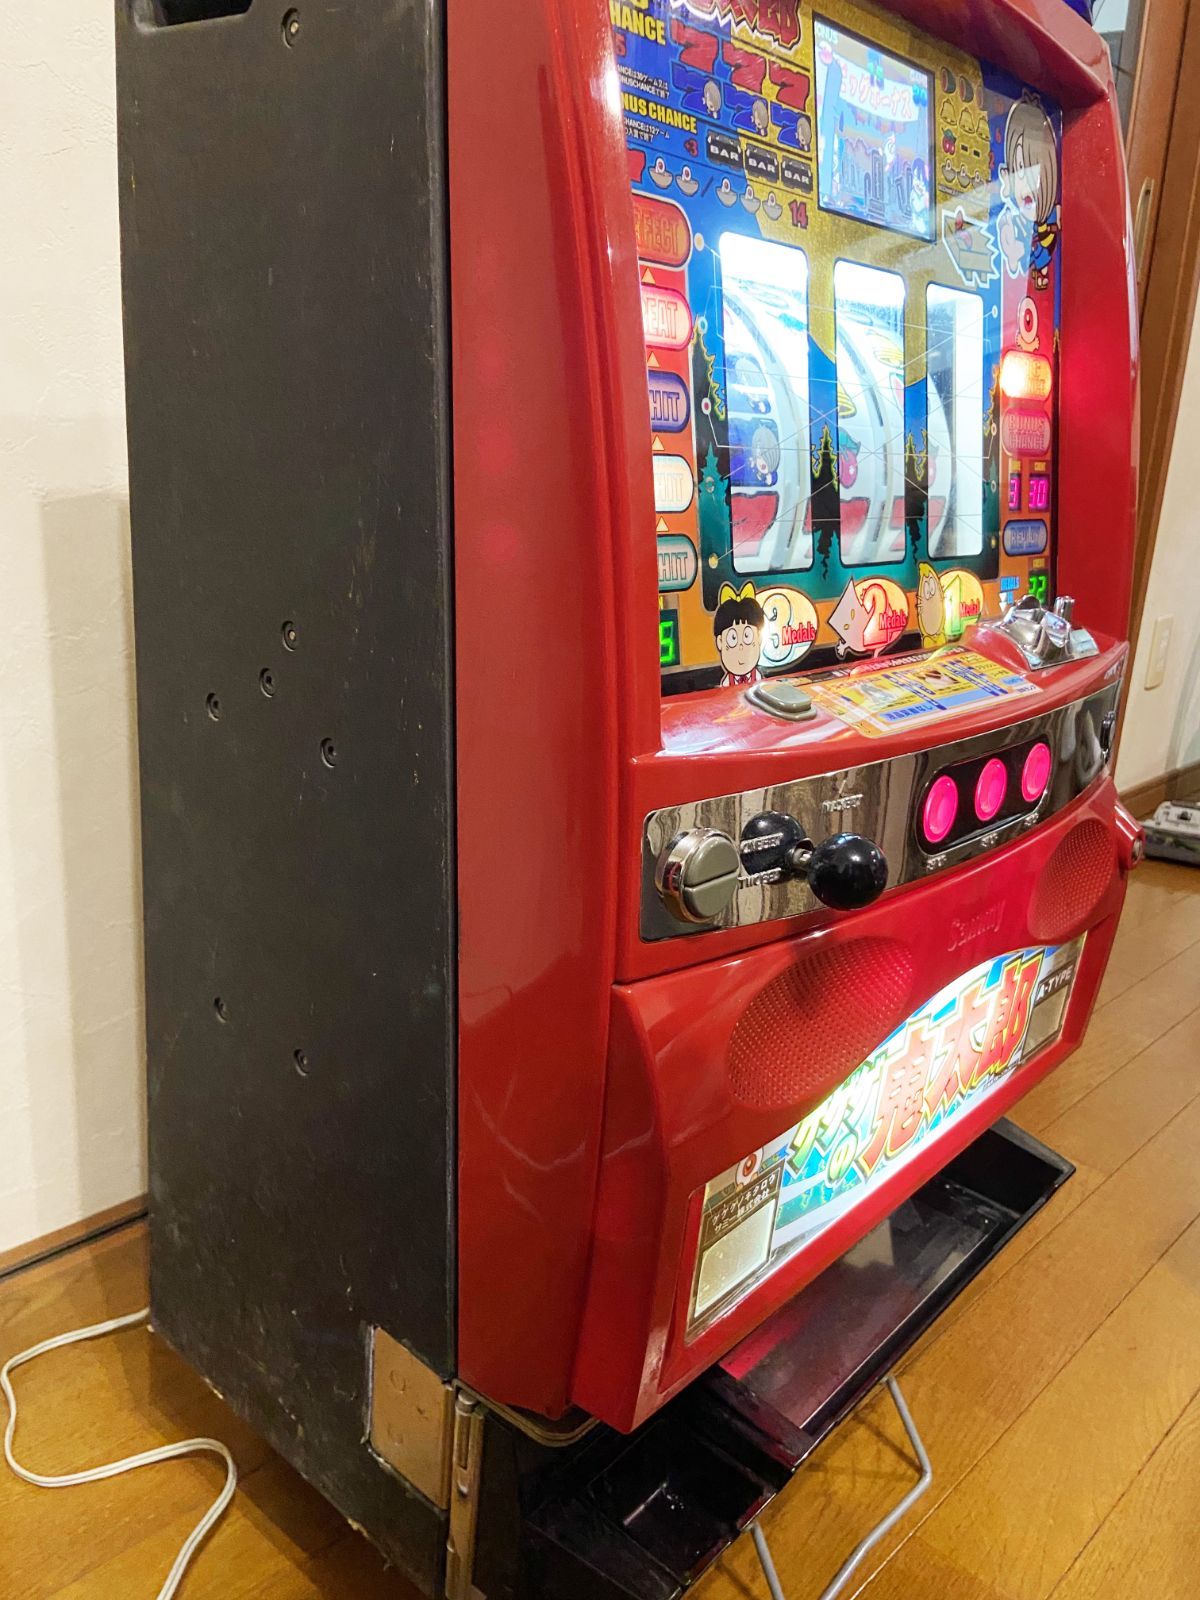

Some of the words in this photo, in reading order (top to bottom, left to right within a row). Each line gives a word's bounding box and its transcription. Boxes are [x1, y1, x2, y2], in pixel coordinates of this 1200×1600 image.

[648, 101, 698, 134] CHANCE
[710, 144, 739, 161] BAR
[748, 157, 776, 173] BAR
[784, 170, 810, 184] BAR
[788, 200, 809, 229] 14
[643, 296, 678, 340] EAT
[1008, 413, 1045, 432] BONUS
[1008, 479, 1018, 508] 3
[1028, 479, 1049, 508] 30
[862, 583, 890, 647] 2
[878, 608, 908, 630] Medals
[943, 575, 961, 634] 1
[763, 593, 793, 662] 3
[782, 621, 817, 645] Medals
